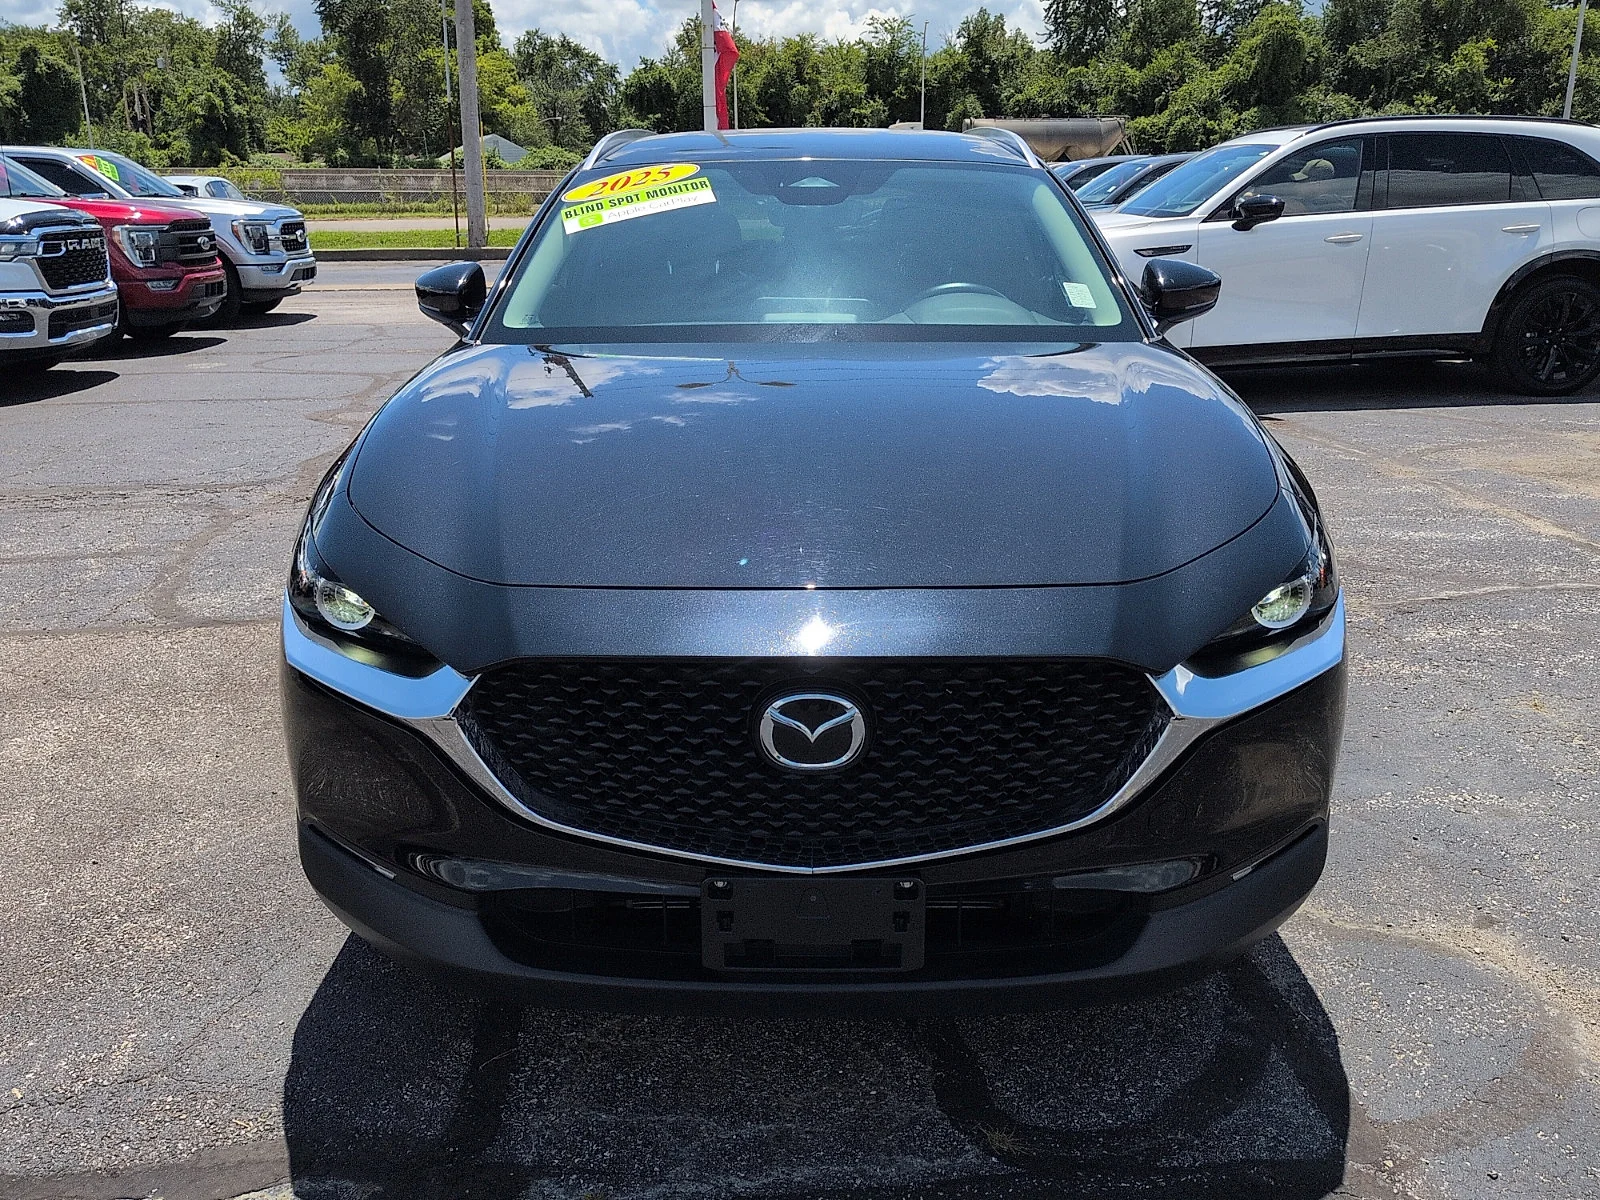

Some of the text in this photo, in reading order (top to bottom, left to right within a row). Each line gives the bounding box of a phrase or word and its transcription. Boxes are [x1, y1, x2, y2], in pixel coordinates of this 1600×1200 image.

[587, 167, 674, 197] 2025
[564, 180, 708, 219] BLIND SPOT MONITOR
[608, 196, 698, 219] Apple CarPlay
[67, 237, 101, 250] RAM
